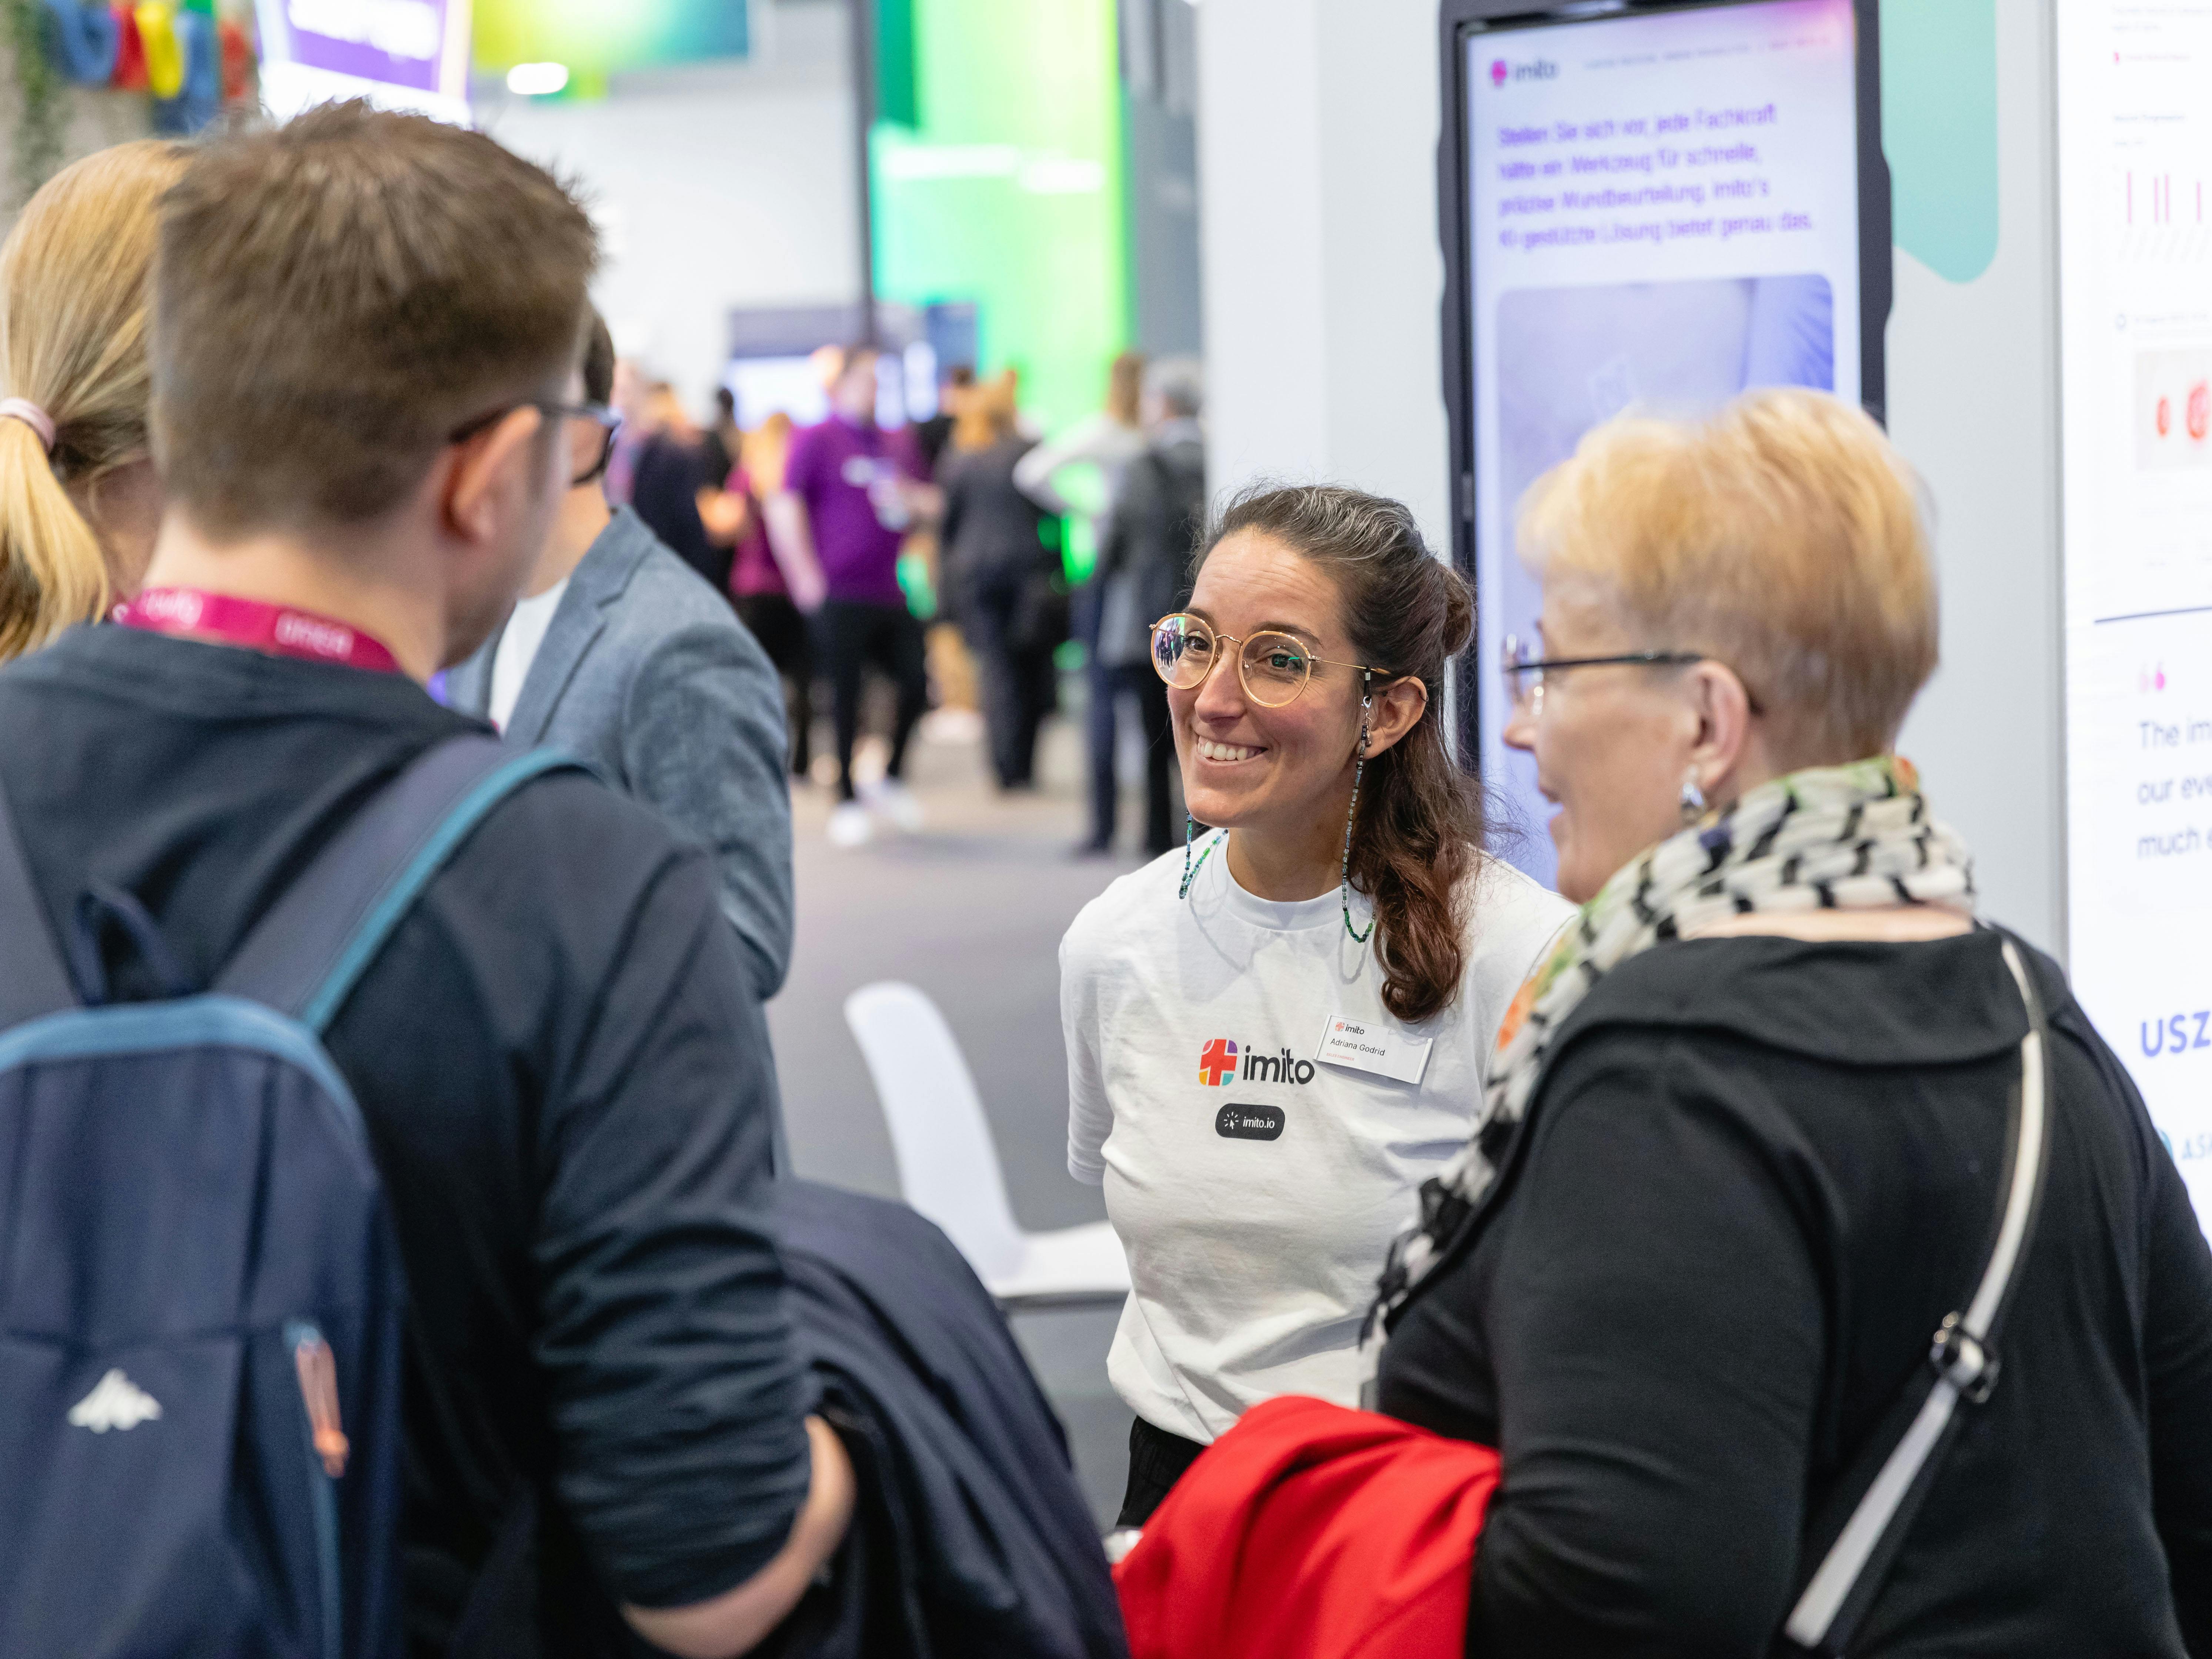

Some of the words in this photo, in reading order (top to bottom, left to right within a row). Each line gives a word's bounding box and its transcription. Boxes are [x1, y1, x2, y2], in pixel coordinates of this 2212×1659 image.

[1695, 103, 1776, 129] Fachkraft
[1572, 153, 1652, 176] Werkzeug
[1669, 218, 1714, 239] bietet
[1722, 217, 1772, 241] genau
[2139, 720, 2180, 747] The
[2138, 781, 2173, 804] our
[2139, 827, 2200, 858] much
[1345, 1024, 1364, 1034] imito
[2142, 1011, 2211, 1057] USZ
[1330, 1038, 1357, 1049] Adriana
[1359, 1044, 1385, 1056] Godrid
[1243, 1045, 1315, 1084] imito
[1243, 1116, 1275, 1129] imito.io
